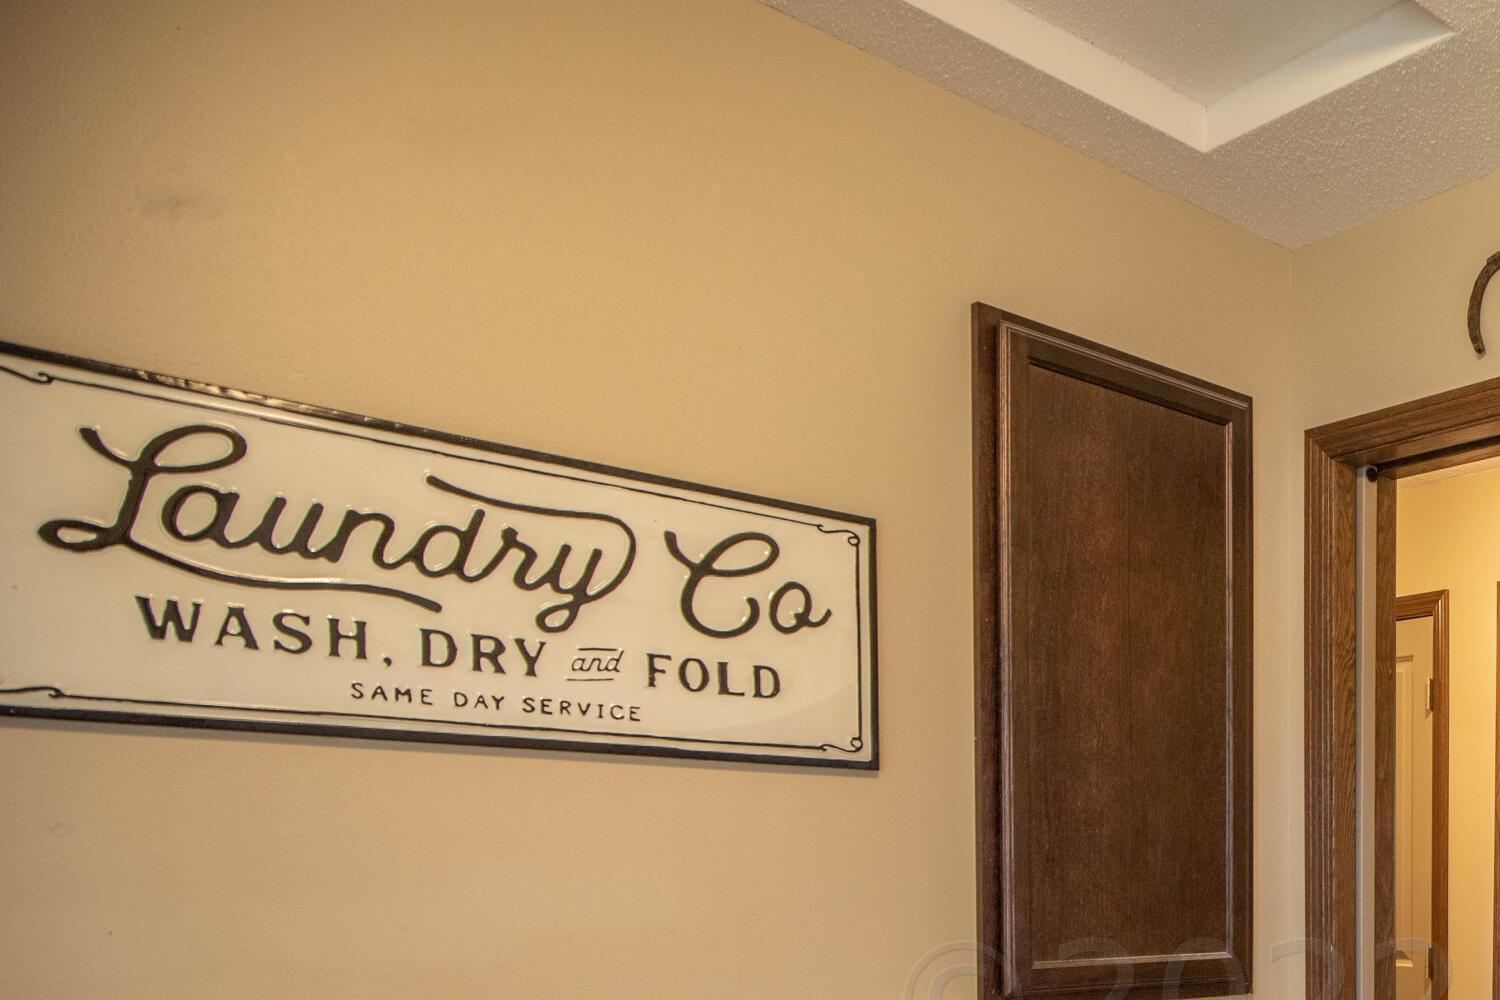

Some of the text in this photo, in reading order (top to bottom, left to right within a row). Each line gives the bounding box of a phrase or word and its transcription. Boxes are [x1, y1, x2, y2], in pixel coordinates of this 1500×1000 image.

[37, 424, 832, 639] Laundry Co
[135, 595, 781, 699] WASH, DRY and FOLD
[351, 682, 641, 722] SAME DAY SERVICE
